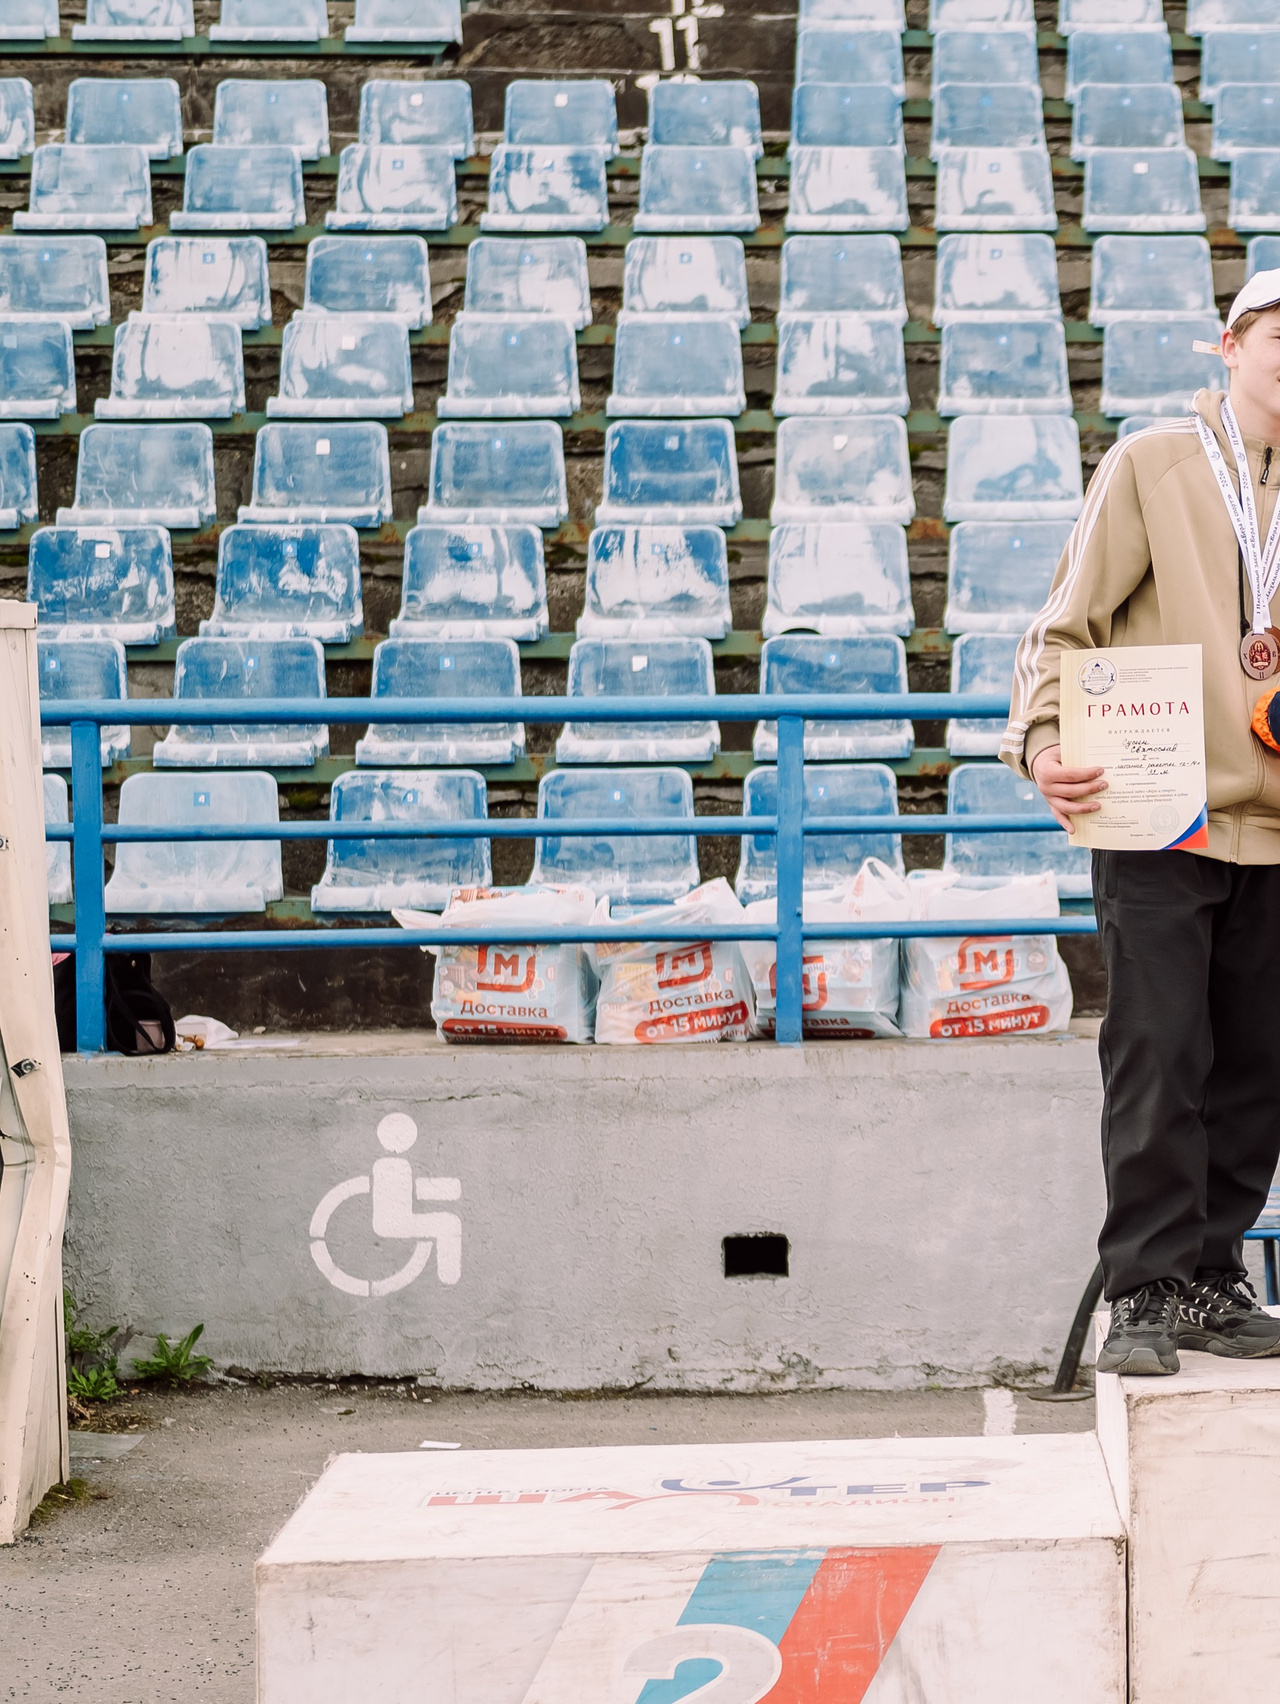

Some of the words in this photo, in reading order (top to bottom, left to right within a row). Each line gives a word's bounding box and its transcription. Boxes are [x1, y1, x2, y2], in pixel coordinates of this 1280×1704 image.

[648, 14, 701, 71] 11
[1087, 701, 1190, 718] ГРАМОТА
[460, 1000, 549, 1019] Доставка
[649, 988, 734, 1015] Доставка
[946, 992, 1032, 1015] Доставка
[454, 1024, 474, 1034] от
[478, 1024, 497, 1034] 15
[502, 1026, 557, 1038] минут
[646, 1023, 666, 1038] от
[670, 1017, 690, 1033] 15
[694, 1008, 743, 1029] минут
[767, 1016, 850, 1030] Дтавка
[940, 1024, 961, 1038] от
[965, 1018, 985, 1034] 15
[988, 1012, 1040, 1031] минут
[771, 1496, 956, 1507] СТАДИОН
